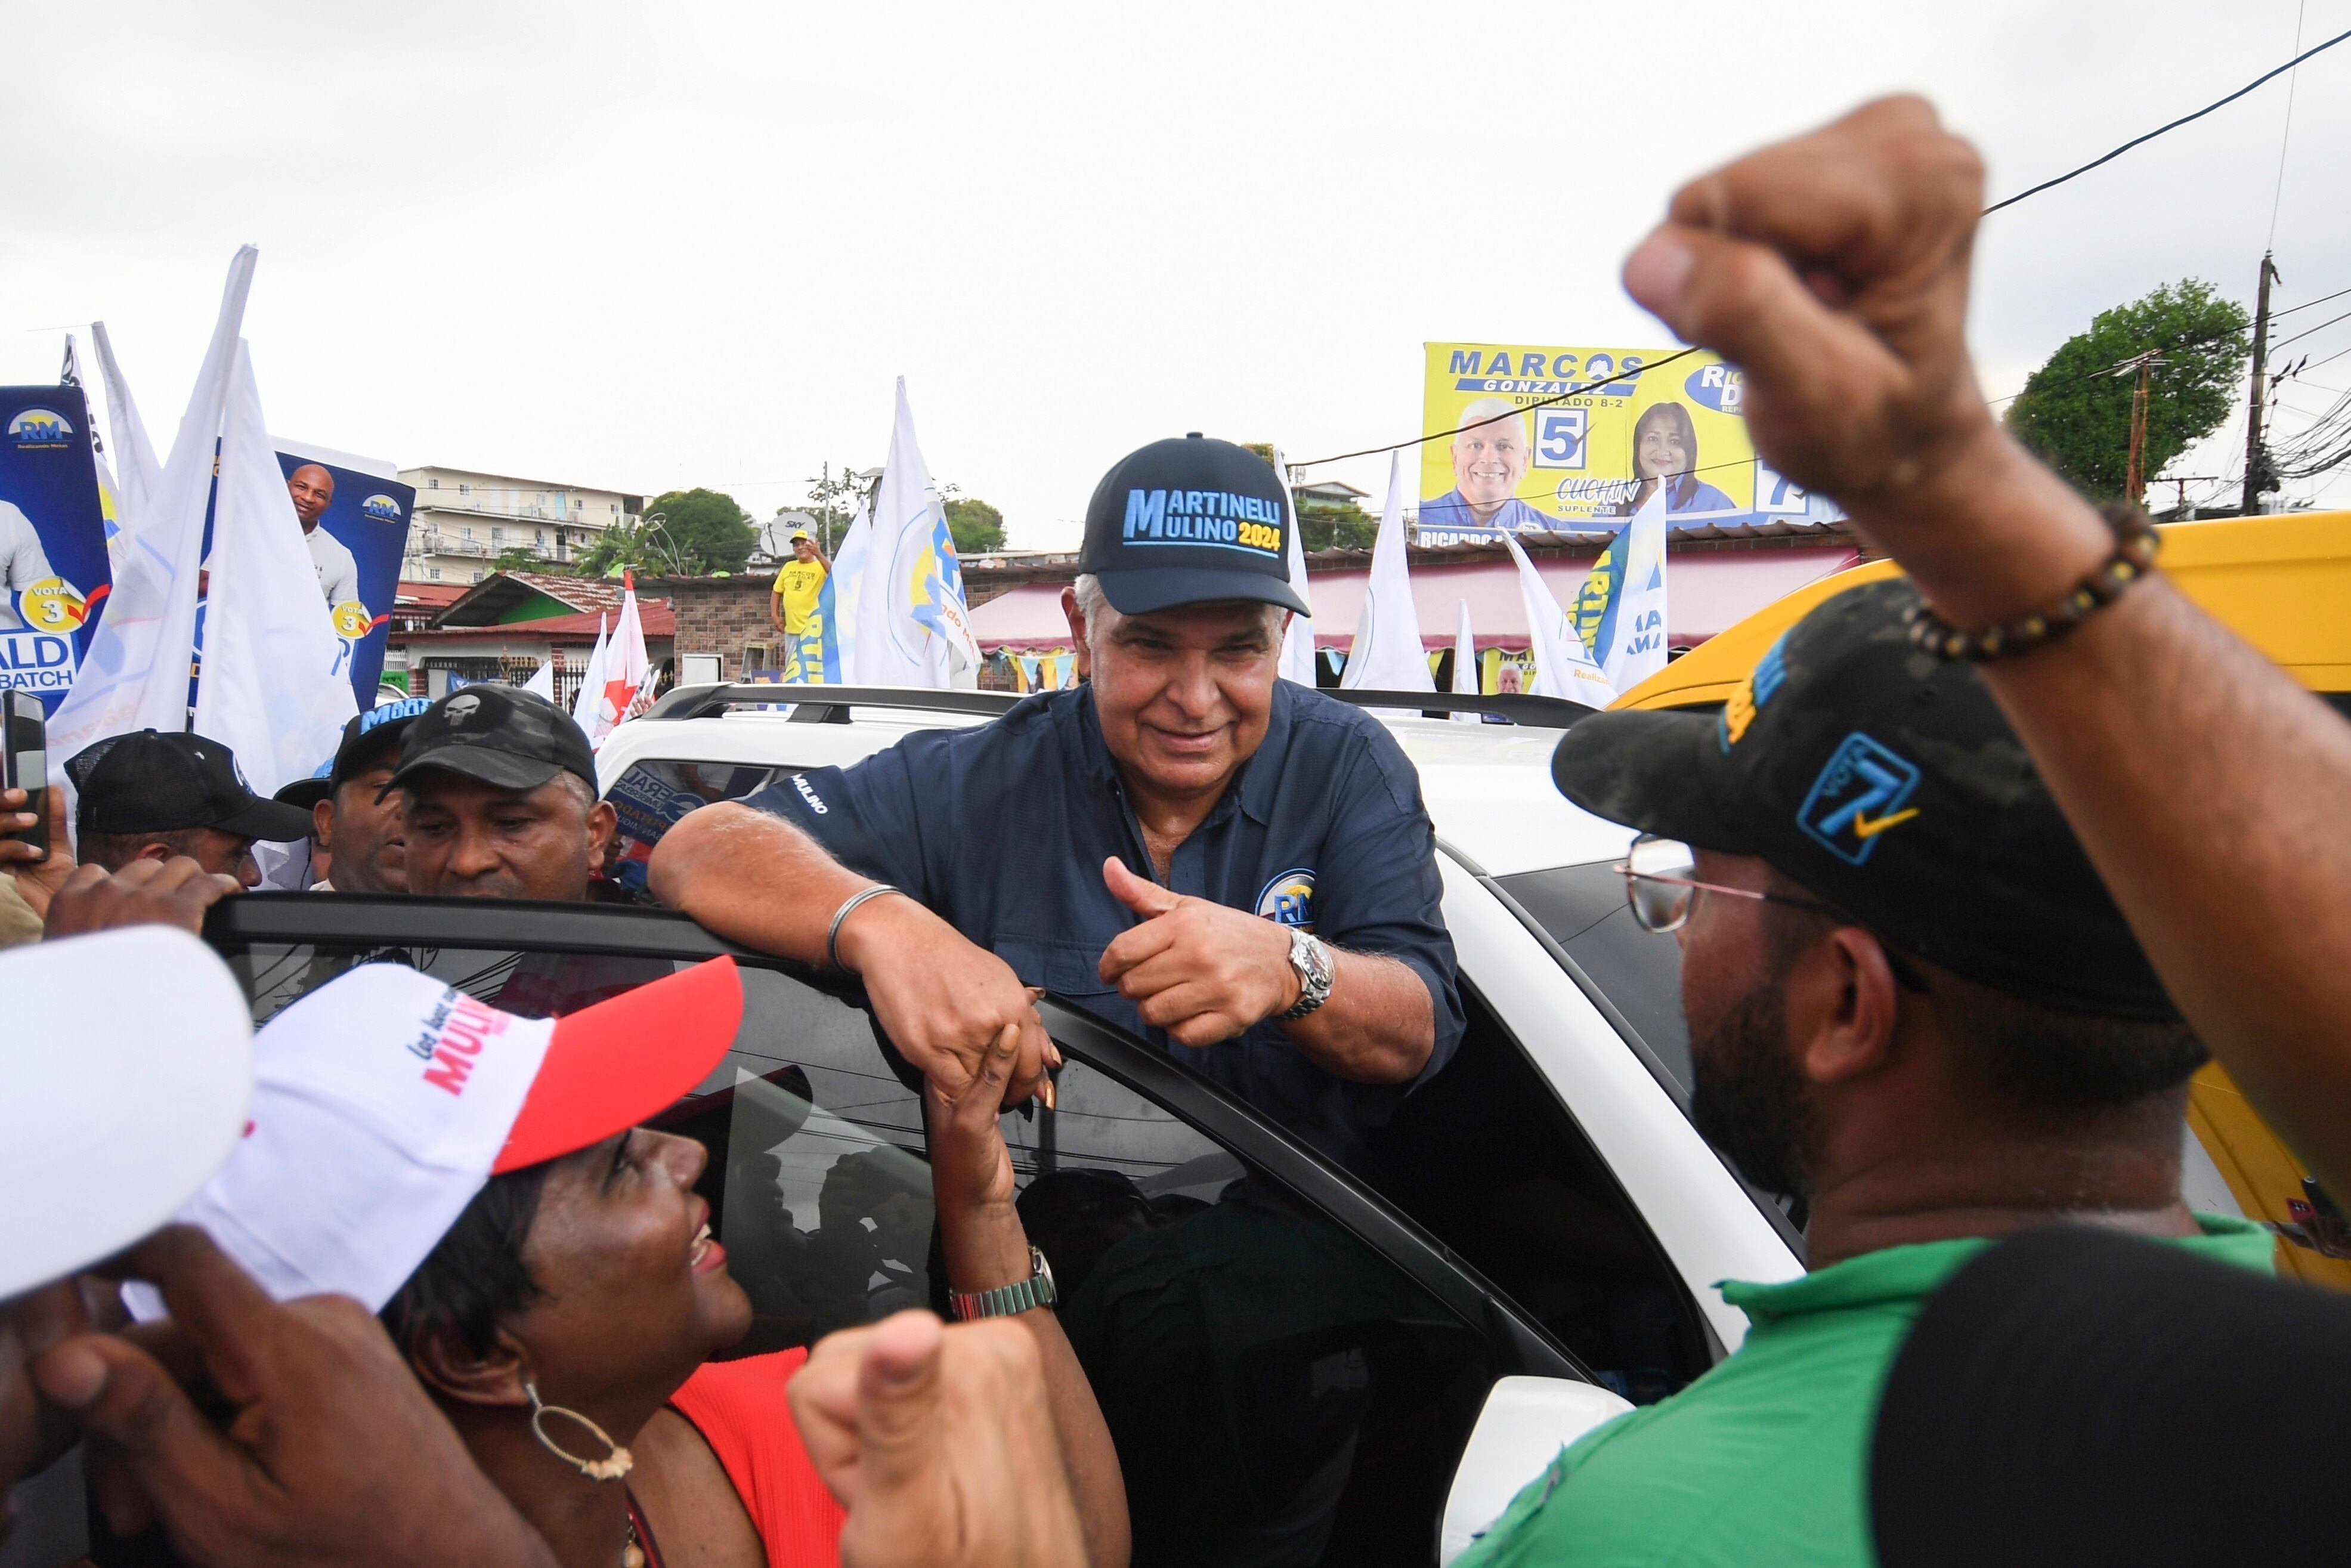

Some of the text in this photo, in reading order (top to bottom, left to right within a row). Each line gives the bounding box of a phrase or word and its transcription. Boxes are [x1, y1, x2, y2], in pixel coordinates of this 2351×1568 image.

[1449, 350, 1643, 381] MARCOS
[1483, 379, 1606, 395] GONZALEZ
[1515, 396, 1623, 408] DIPUTADO 8-2
[20, 421, 62, 440] RM
[1540, 417, 1579, 461] 5
[369, 500, 395, 518] RM
[1123, 488, 1282, 537] MARTINELLI
[1557, 505, 1616, 515] SUPLENTE
[1238, 521, 1282, 552] 2024
[33, 586, 68, 596] VOTA
[41, 600, 64, 623] 3
[342, 605, 362, 615] VOTA
[342, 616, 357, 631] 3
[791, 773, 829, 815] MULINO
[1817, 758, 1902, 835] 7
